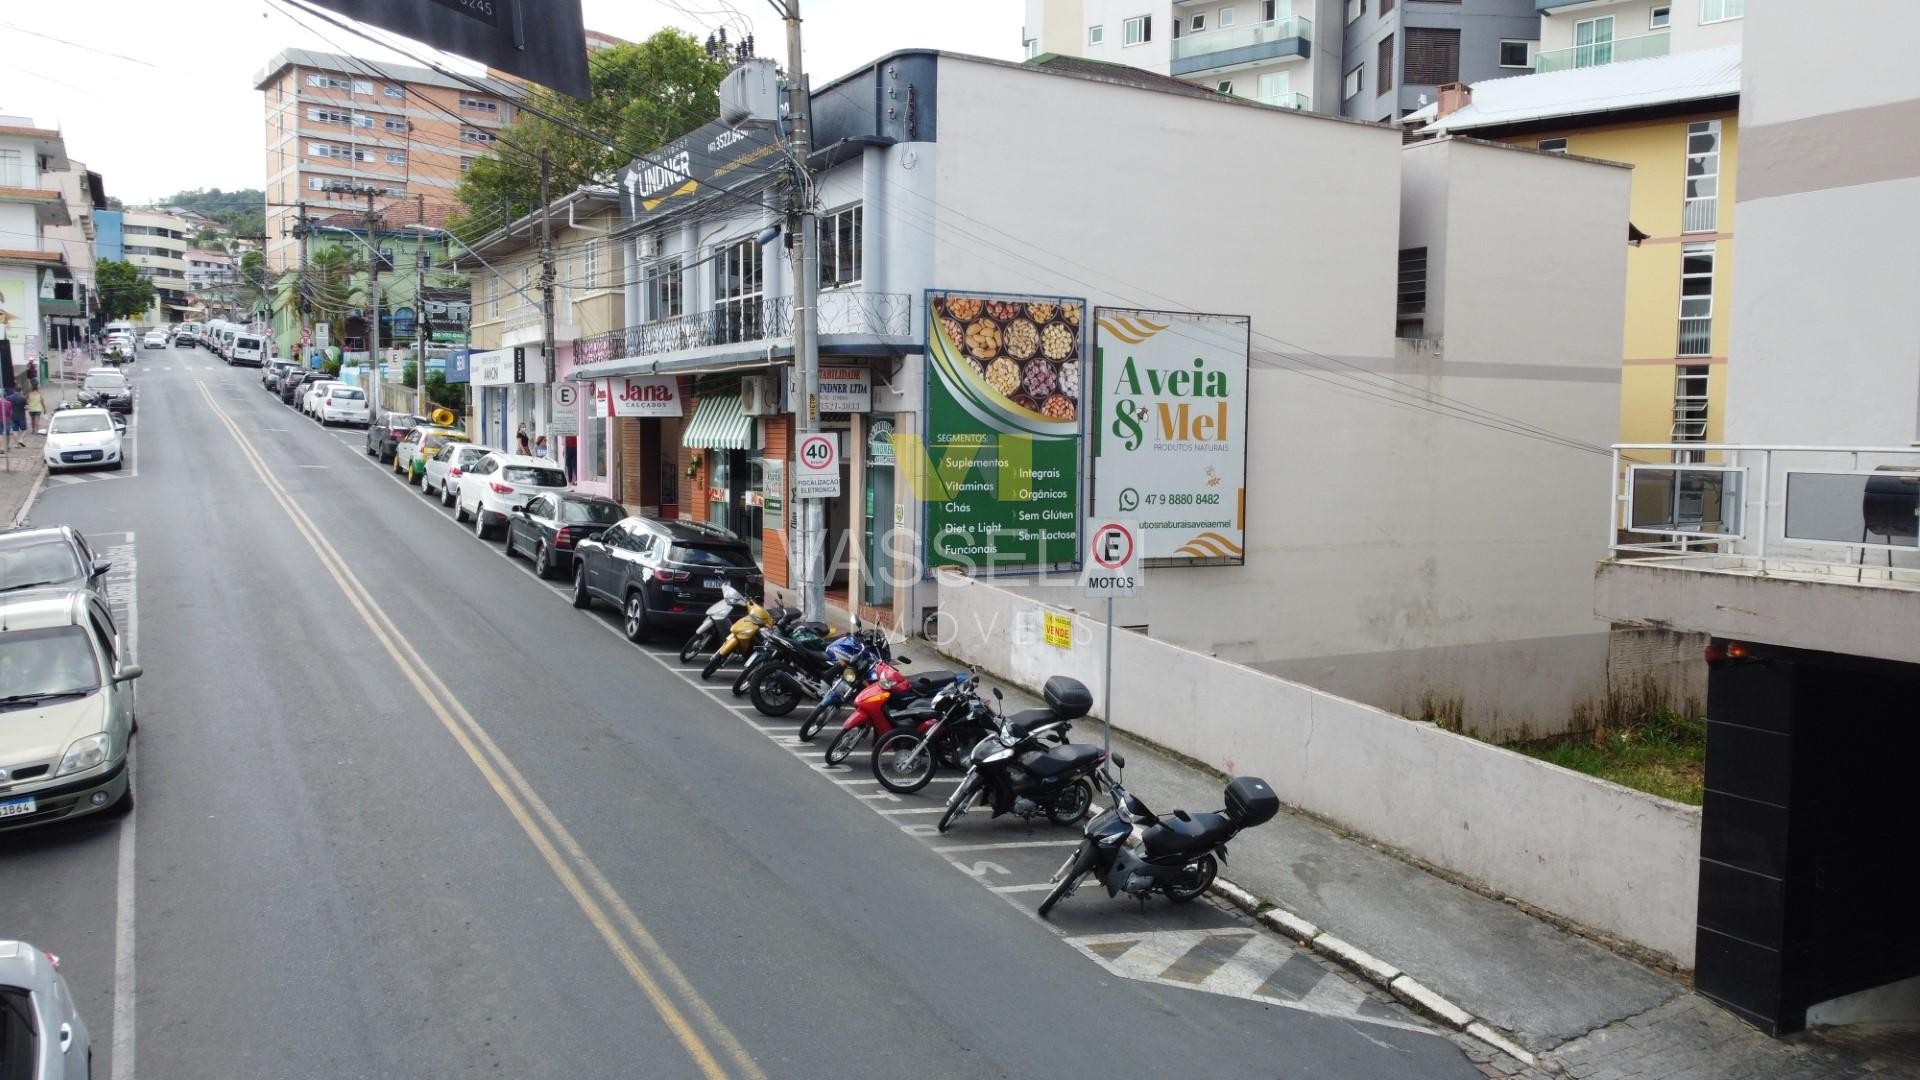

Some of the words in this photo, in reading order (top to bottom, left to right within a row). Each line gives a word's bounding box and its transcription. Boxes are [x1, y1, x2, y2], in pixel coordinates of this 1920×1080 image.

[638, 150, 692, 198] LINDNER
[1114, 356, 1231, 398] Aveia
[619, 378, 673, 401] Jana
[819, 383, 848, 394] INDNER
[849, 383, 868, 394] LTDA
[561, 389, 570, 402] E
[1112, 399, 1144, 452] &
[1154, 401, 1229, 442] Mel
[806, 444, 828, 459] 40
[1153, 443, 1193, 452] PRODUTOS
[1194, 443, 1230, 452] NATURAIS
[945, 457, 1009, 468] Suplementos
[1019, 467, 1061, 480] Integrais
[798, 478, 839, 487] FISCALIZAÇÃO
[945, 481, 994, 491] Vitaminas
[1019, 489, 1068, 501] Orgânicos
[1145, 494, 1157, 505] 47
[1159, 494, 1166, 505] 9
[1168, 494, 1193, 505] 8880
[1195, 494, 1220, 505] 8482
[945, 502, 971, 513] Chás
[1019, 510, 1039, 521] Sem
[1042, 509, 1074, 520] Glúten
[945, 523, 966, 534] Diet
[978, 522, 1002, 535] Light
[1139, 519, 1232, 529] utosnaturaisaveiaemel
[1019, 531, 1039, 541] Sem
[945, 544, 998, 555] Funcionais
[1104, 532, 1121, 561] E
[1088, 577, 1134, 588] MOTOS
[1046, 624, 1069, 639] VENDE
[0, 803, 29, 816] 1B64
